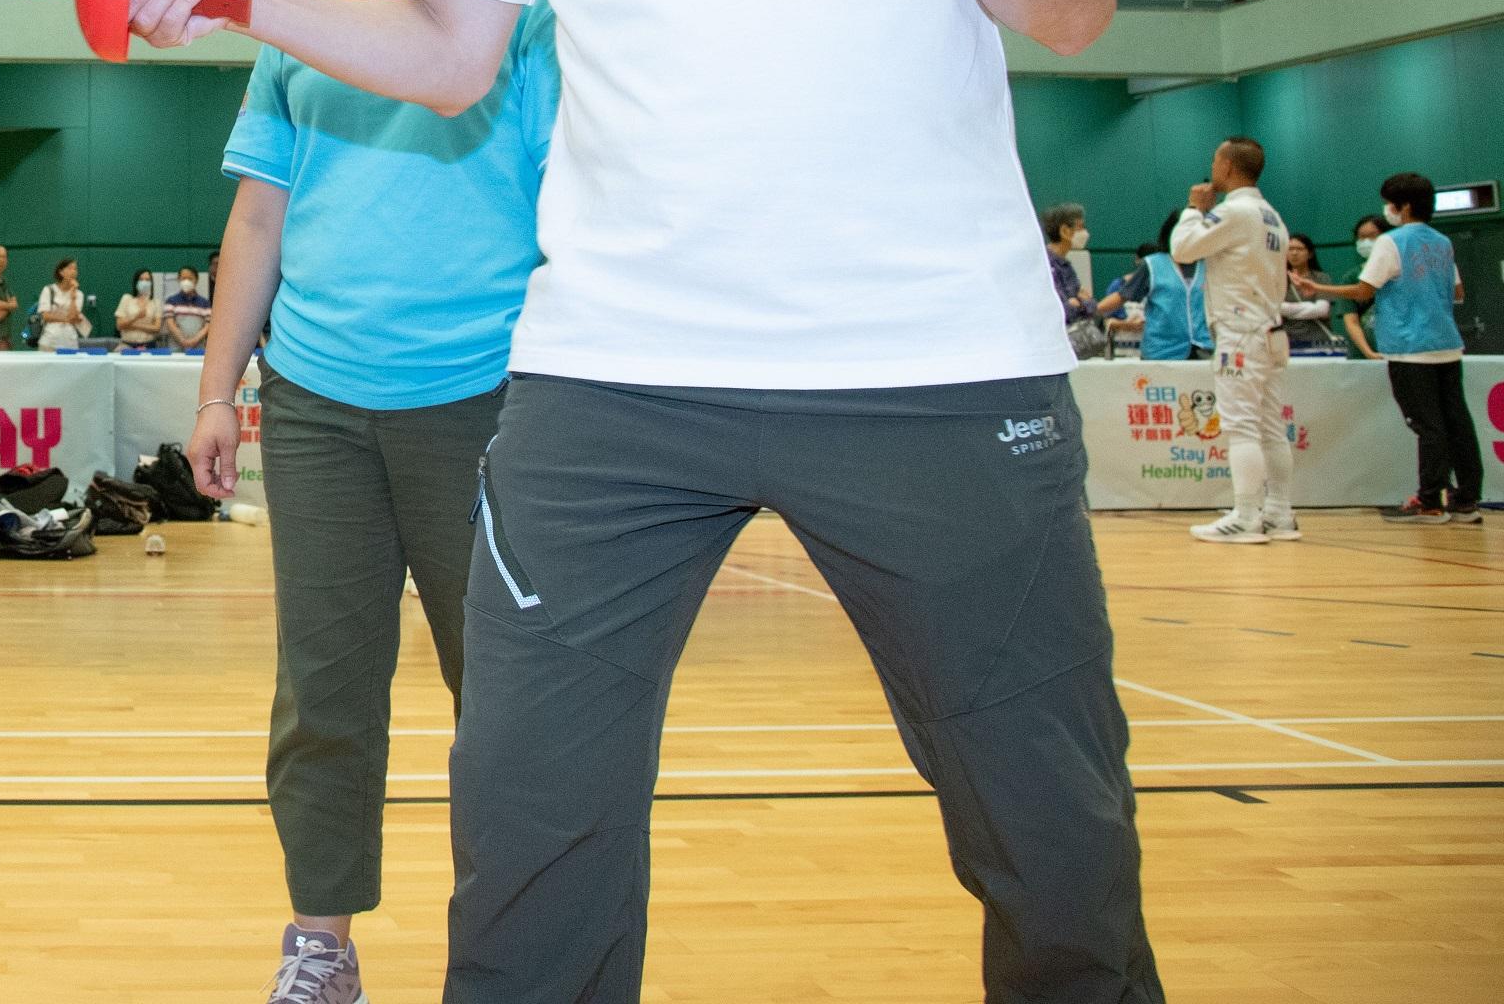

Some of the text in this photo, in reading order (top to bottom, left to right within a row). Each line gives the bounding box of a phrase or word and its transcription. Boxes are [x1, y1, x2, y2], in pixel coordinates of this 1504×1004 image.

[1127, 404, 1174, 426] 運動
[997, 416, 1055, 443] Jeep
[1170, 445, 1205, 464] Stay
[1141, 463, 1204, 482] Healthy
